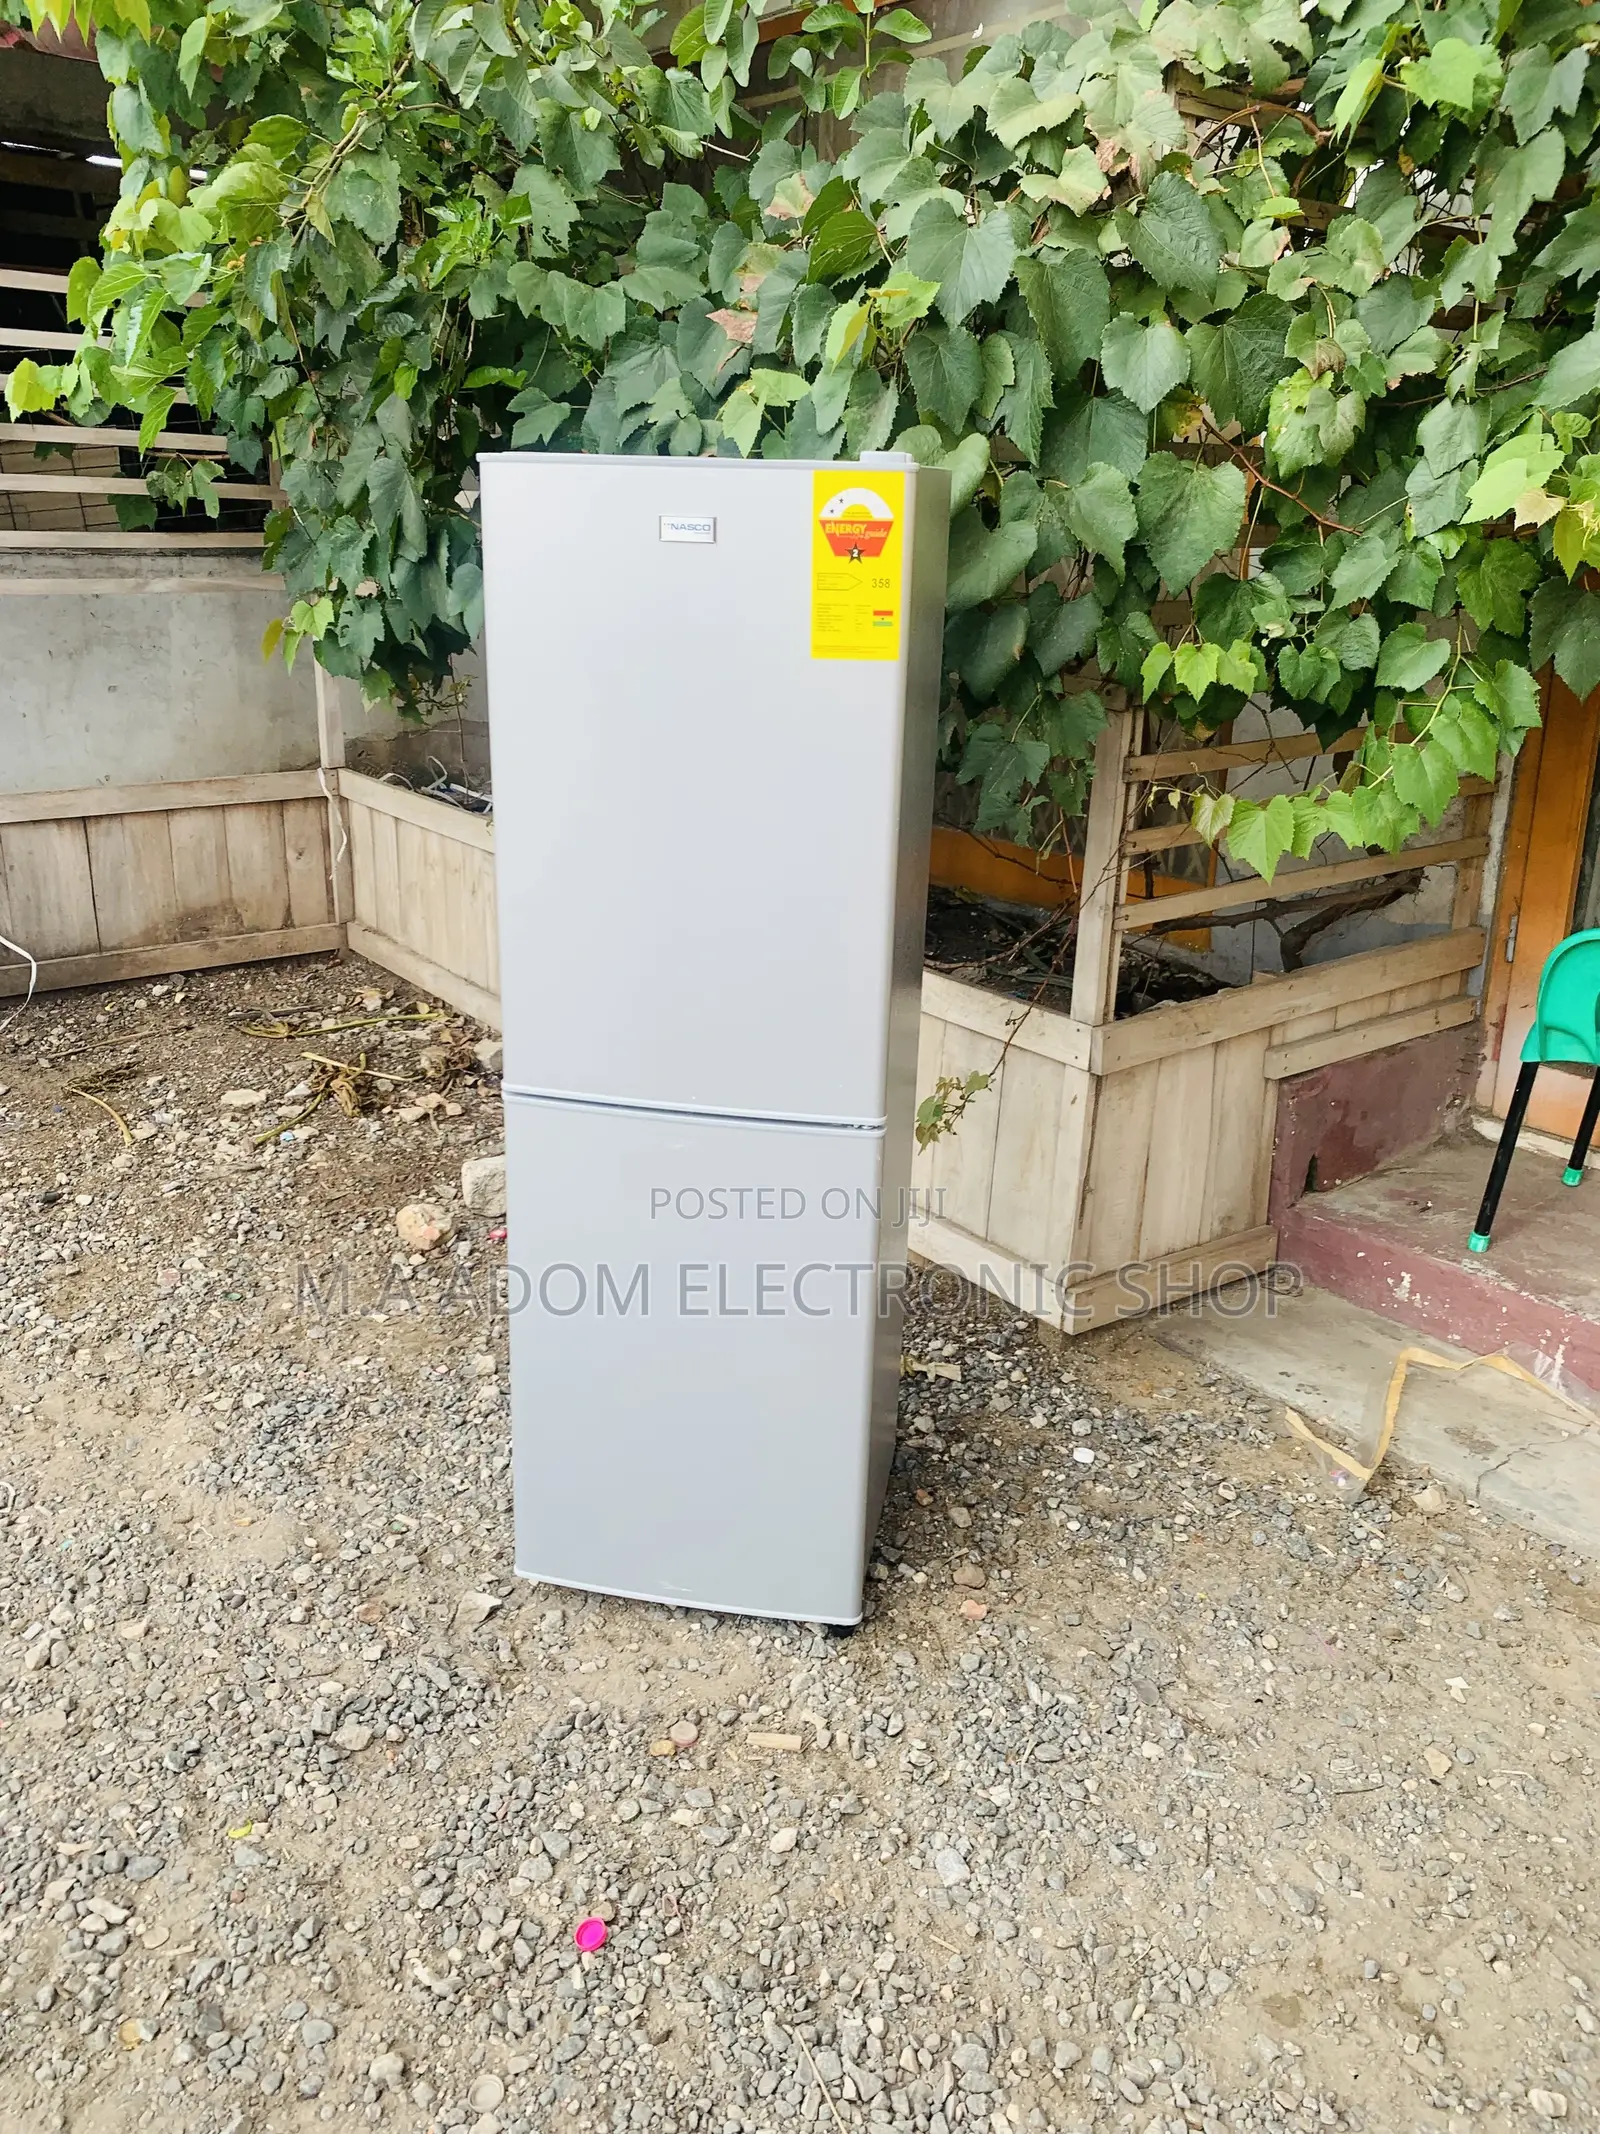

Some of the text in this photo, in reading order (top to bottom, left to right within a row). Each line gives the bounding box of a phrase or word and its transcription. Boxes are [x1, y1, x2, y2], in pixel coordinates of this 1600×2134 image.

[670, 523, 711, 532] NASCO
[824, 521, 867, 536] ENERGY
[852, 549, 859, 557] 2
[871, 578, 891, 589] 358
